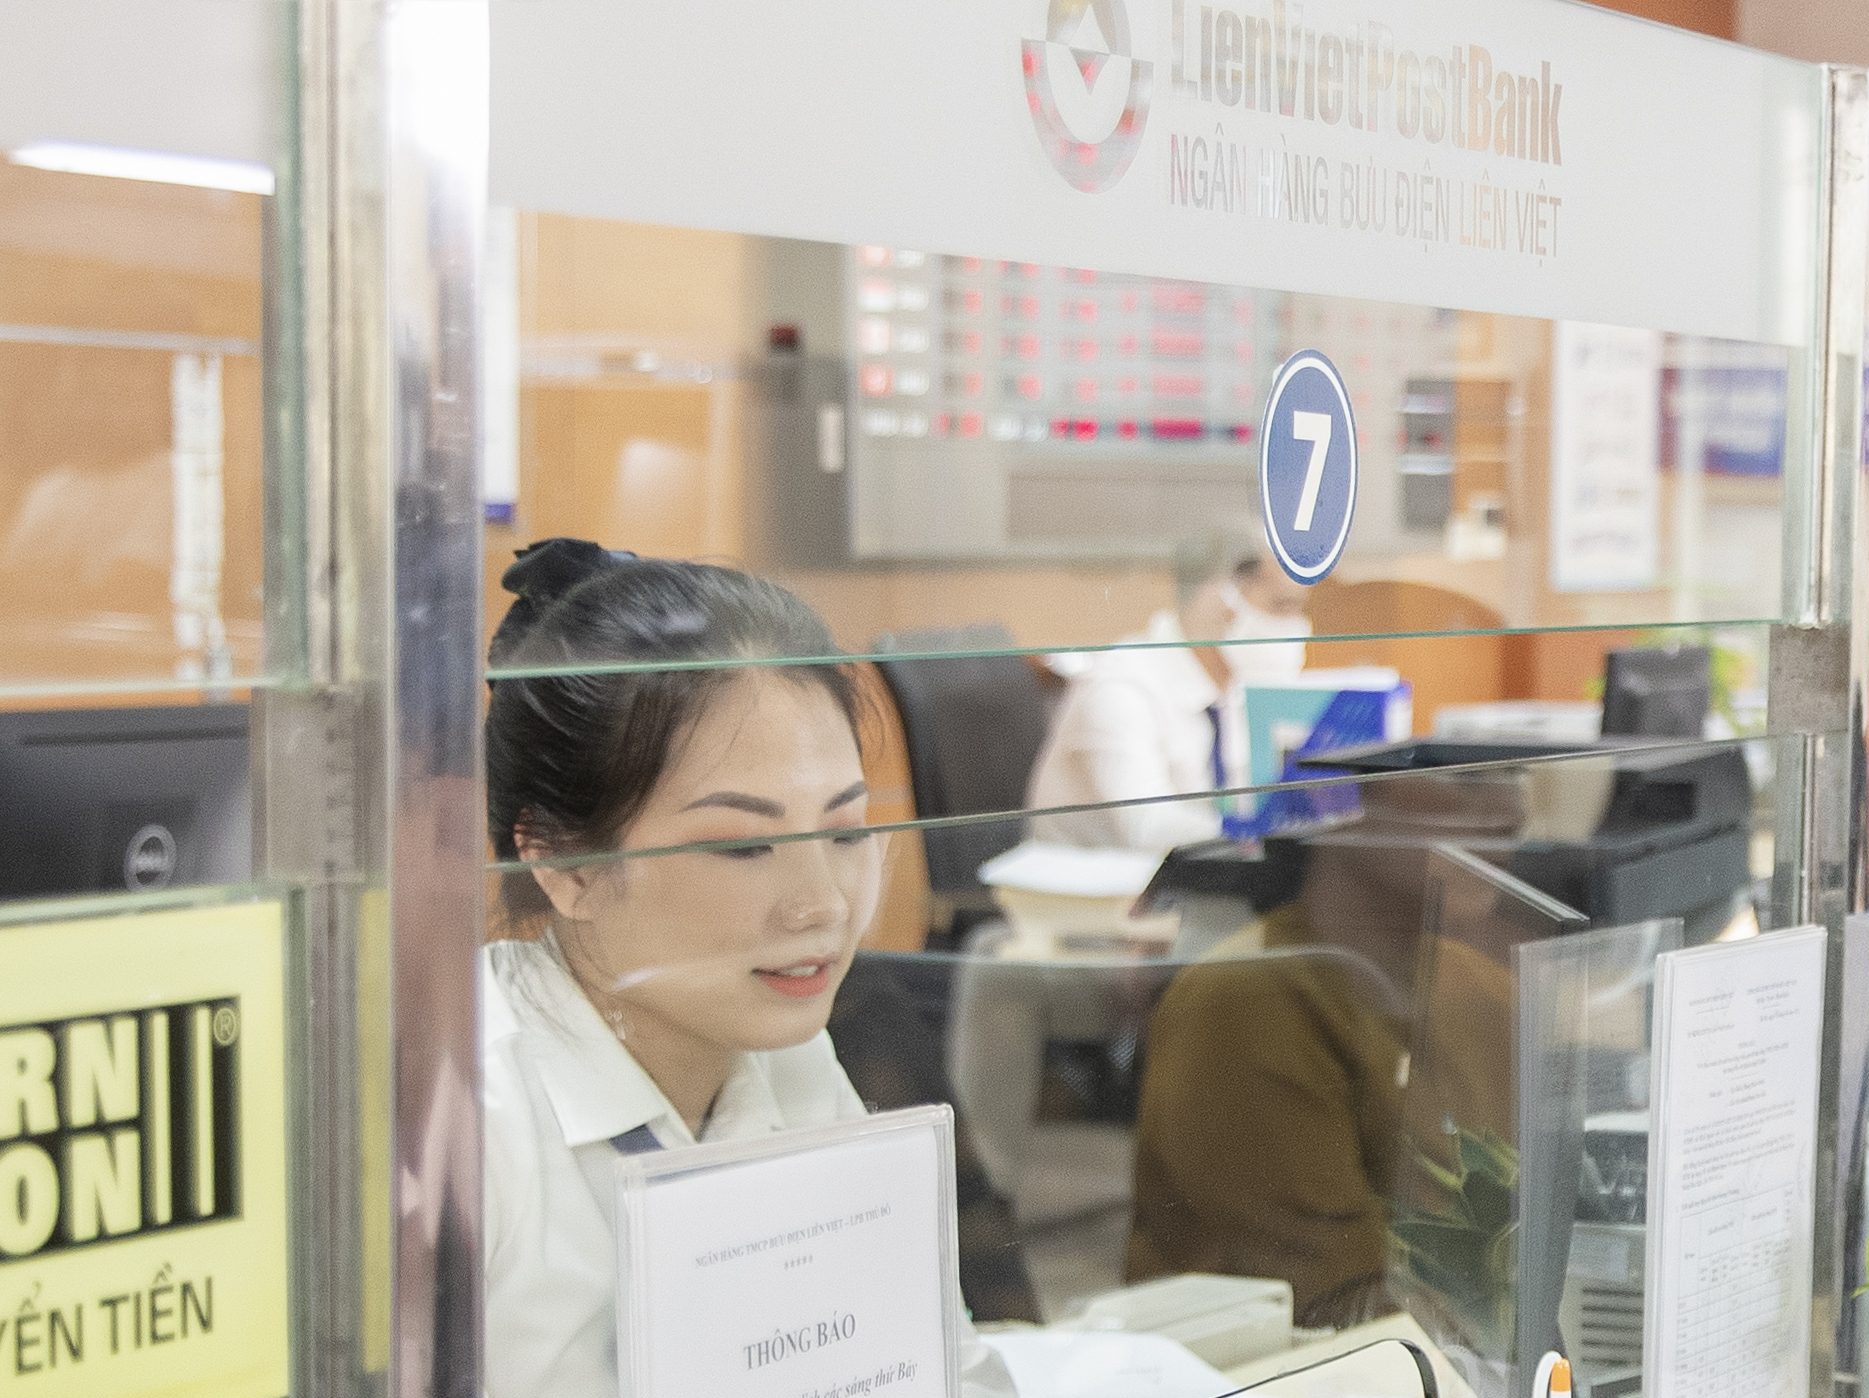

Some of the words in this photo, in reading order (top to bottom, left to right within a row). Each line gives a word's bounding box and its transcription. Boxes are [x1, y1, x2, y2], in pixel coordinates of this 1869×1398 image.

[1170, 123, 1247, 214] NGÂN
[1257, 134, 1329, 225] HÀNG
[1340, 157, 1387, 233] BƯU
[1394, 158, 1449, 253] ĐIỆN
[1459, 169, 1507, 250] LIÊN
[1515, 178, 1562, 267] VIỆT
[1293, 410, 1331, 532] 7
[0, 1281, 84, 1377] ỂN
[99, 1261, 215, 1357] TIỀN
[743, 1328, 811, 1371] THÔNG
[816, 1310, 856, 1348] BÁO
[845, 1376, 872, 1397] sáng
[874, 1365, 895, 1388] thứ
